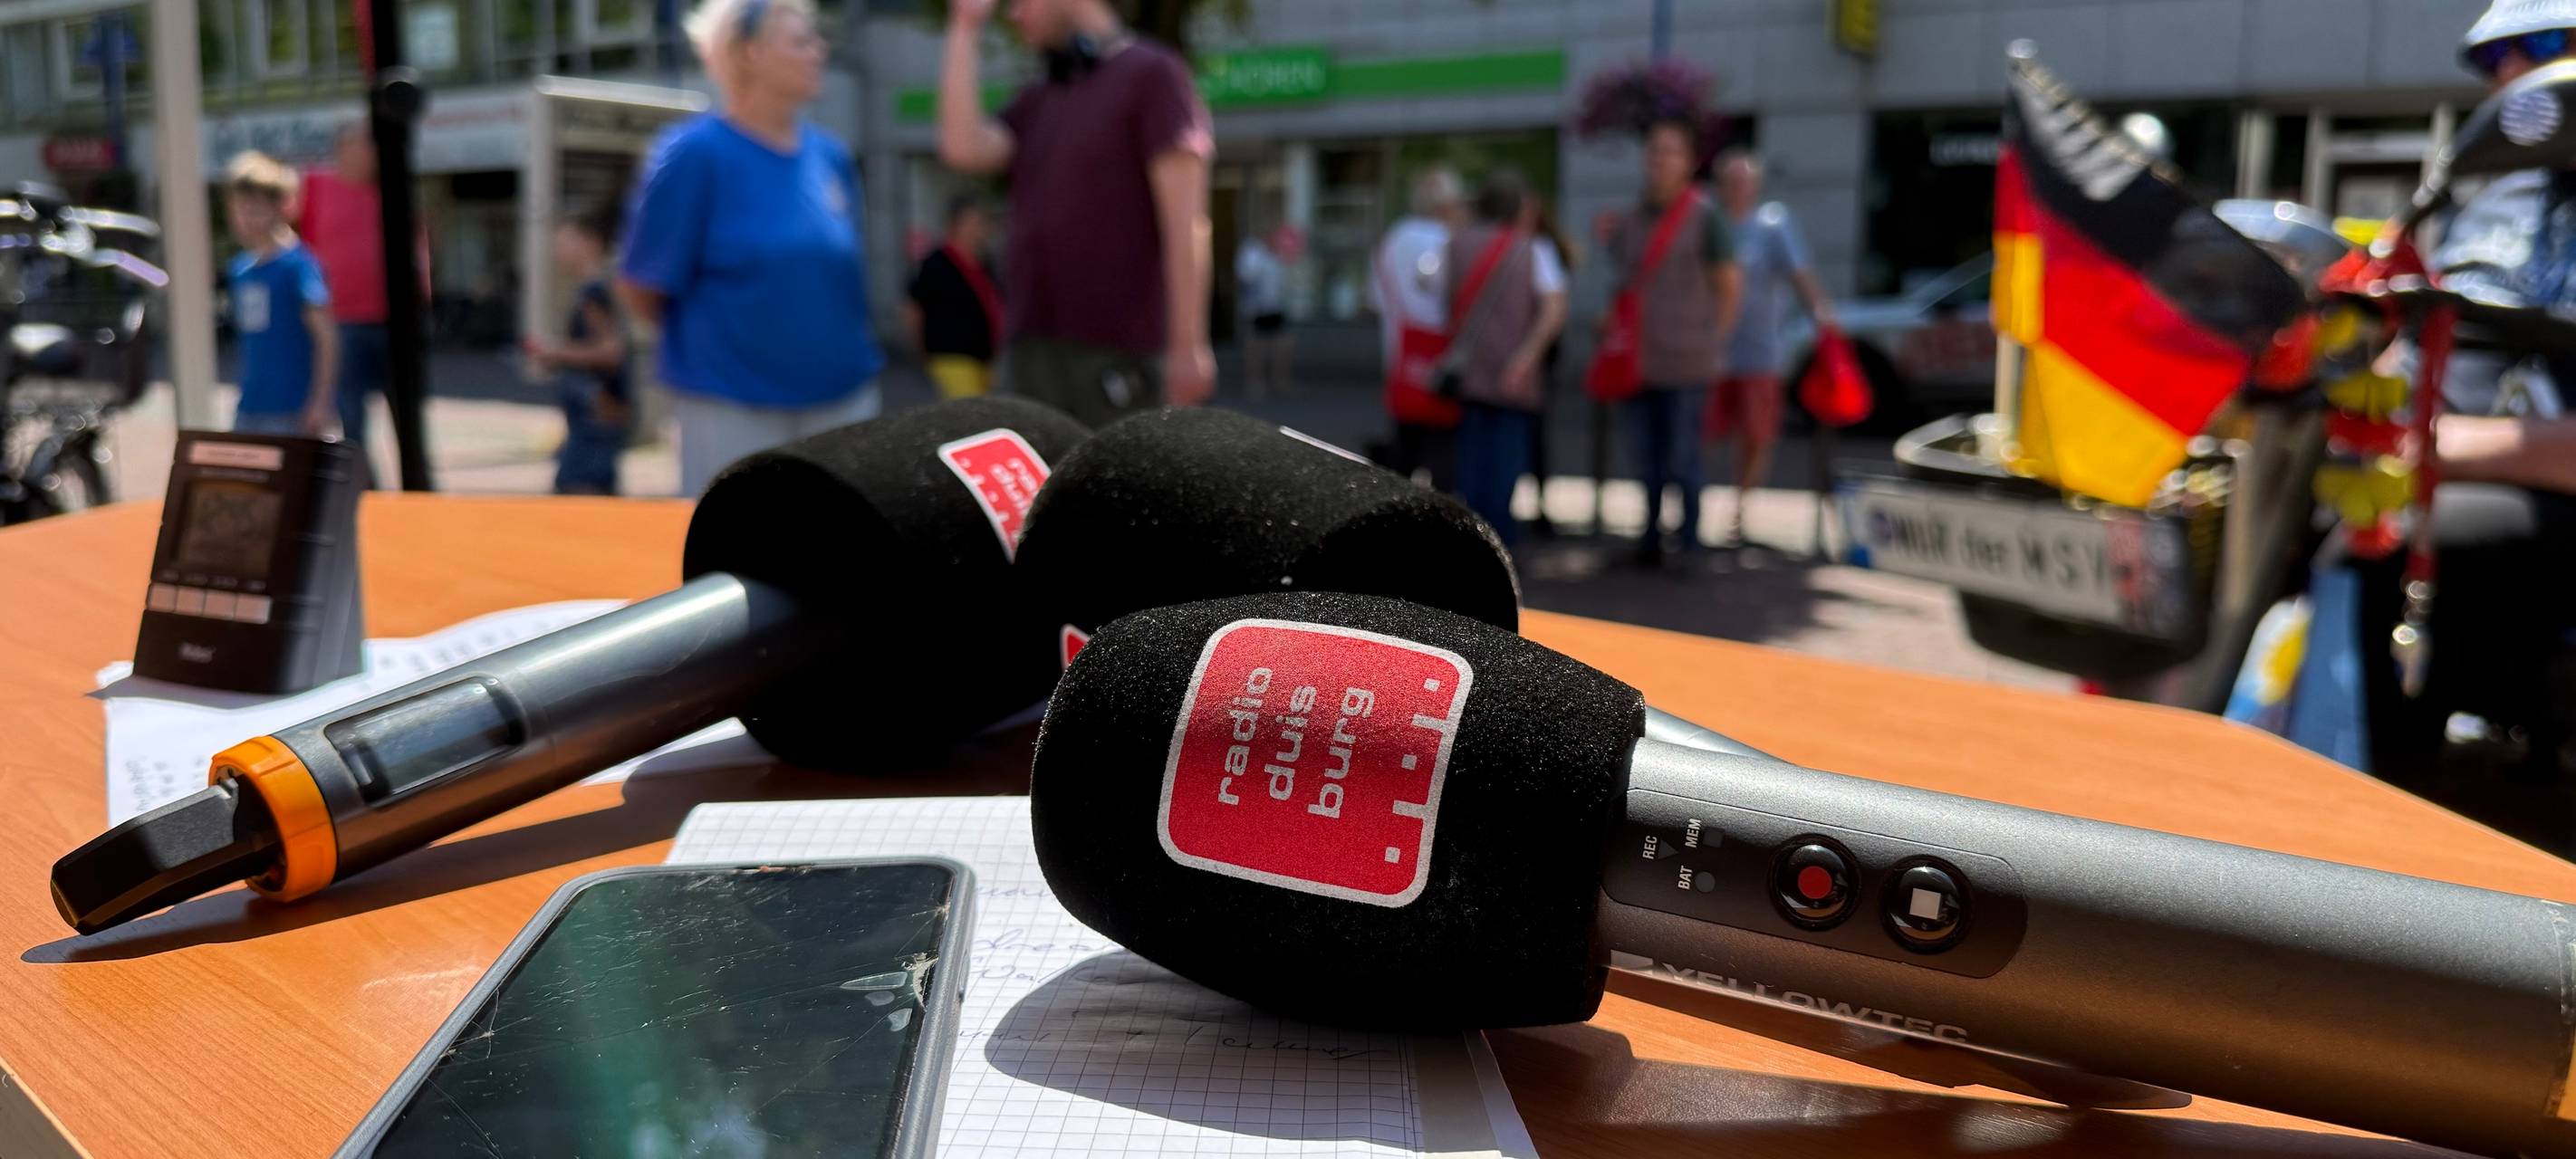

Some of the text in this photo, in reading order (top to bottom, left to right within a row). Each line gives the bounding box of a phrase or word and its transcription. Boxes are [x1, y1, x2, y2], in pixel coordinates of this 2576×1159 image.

[1217, 666, 1273, 806] radio
[1264, 685, 1317, 801] duis
[1307, 686, 1375, 819] burg
[1642, 834, 1658, 860] REC
[1684, 818, 1702, 848] MEM
[1677, 865, 1694, 890] BAT
[1661, 962, 1968, 1043] YELLOWTEC
